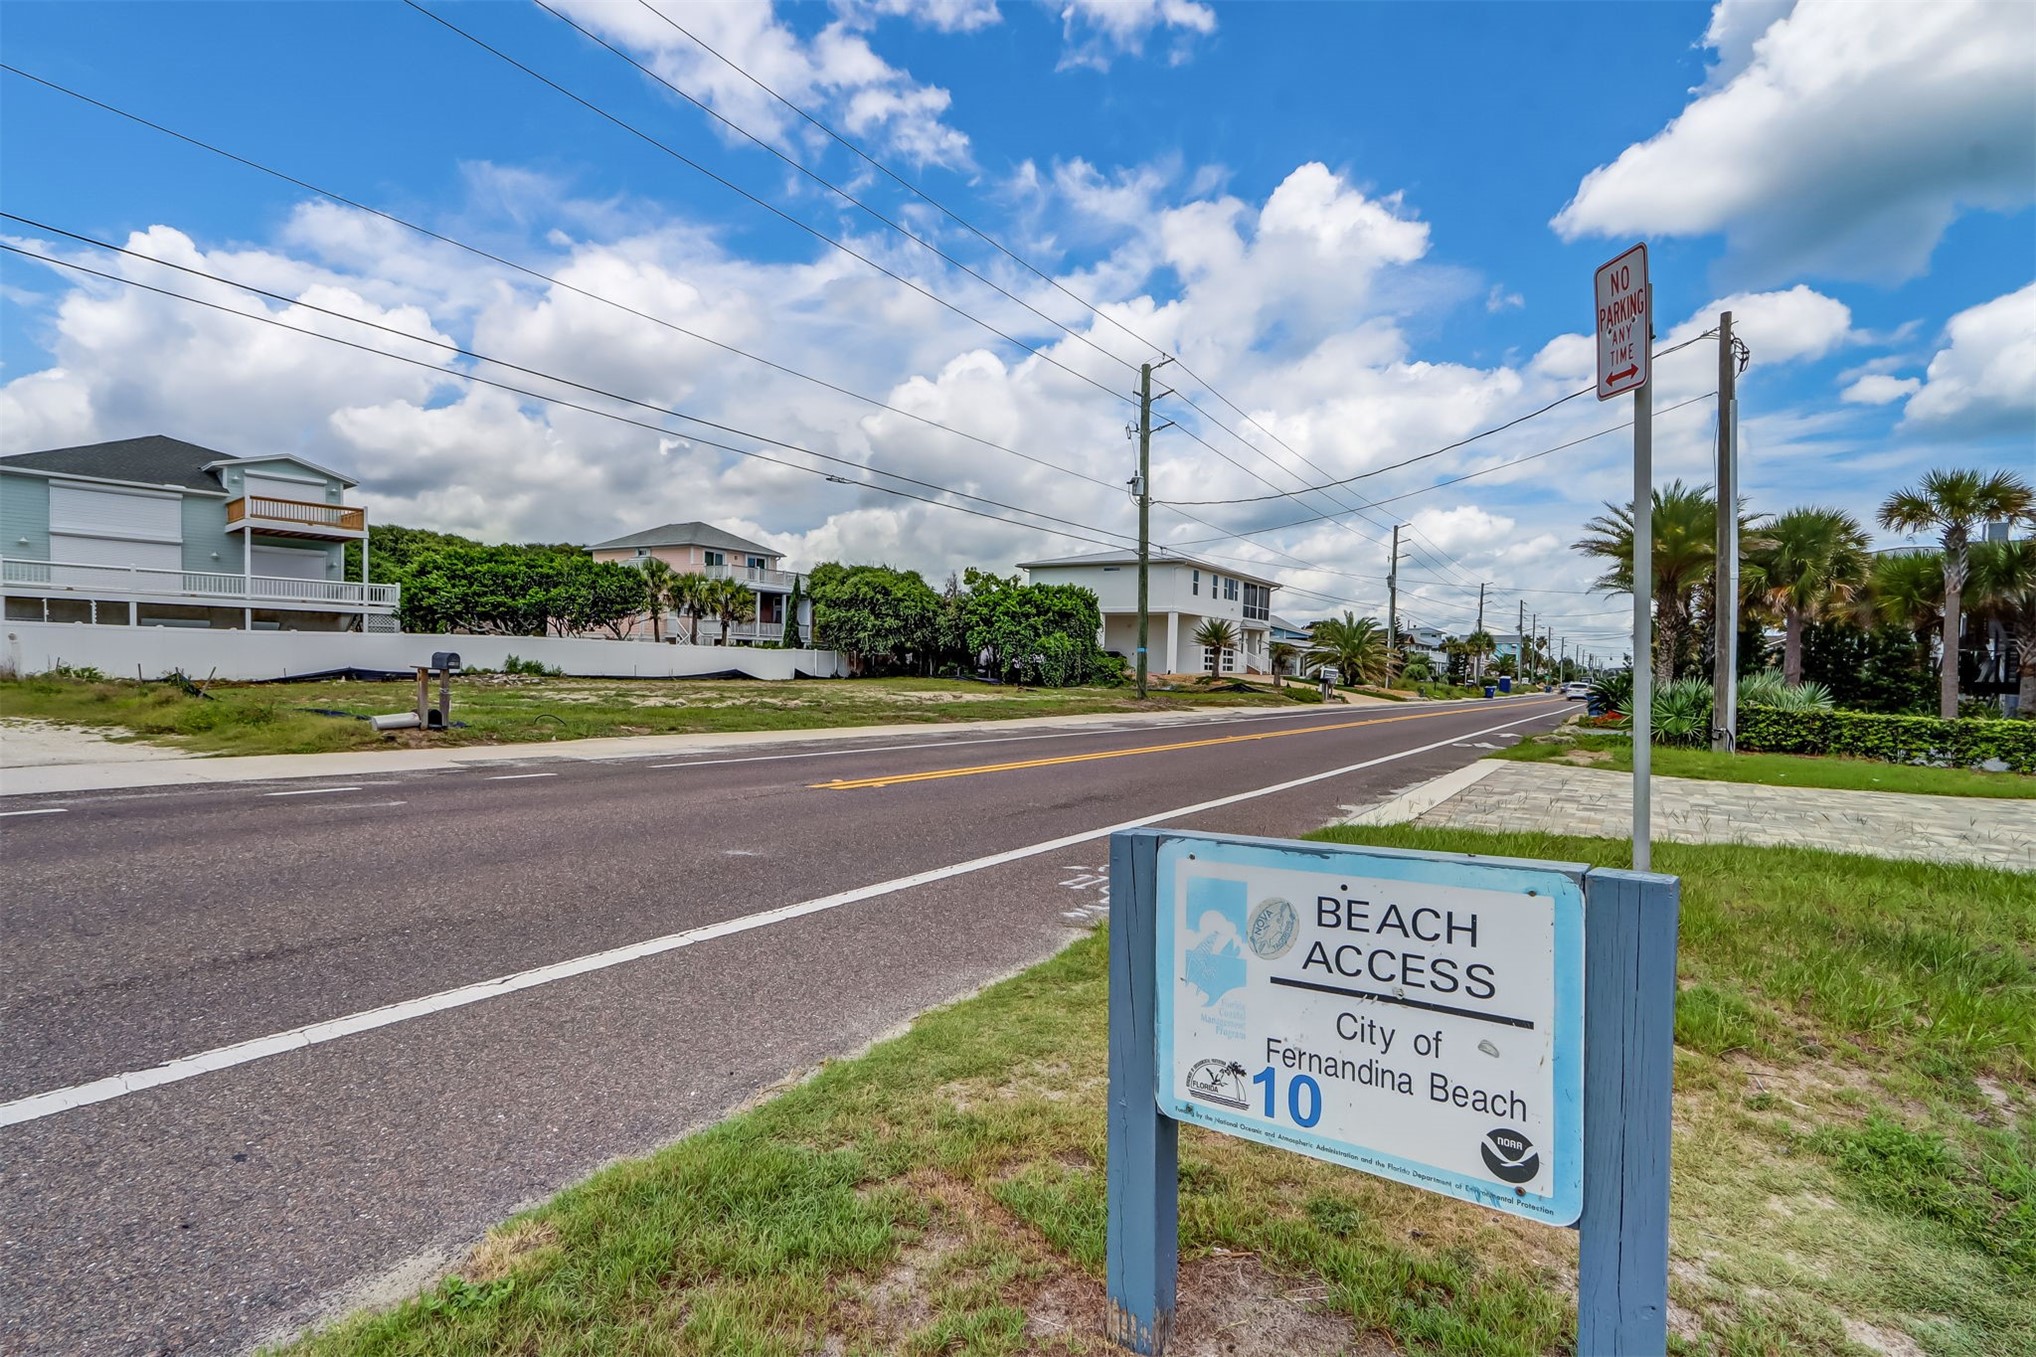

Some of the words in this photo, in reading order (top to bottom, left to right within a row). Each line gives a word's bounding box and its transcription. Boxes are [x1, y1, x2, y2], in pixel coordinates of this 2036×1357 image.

[1610, 265, 1629, 297] NO
[1600, 288, 1644, 332] PARKING
[1610, 343, 1634, 367] TIME
[1612, 323, 1632, 346] ANY
[1254, 909, 1273, 936] NOVA
[1317, 896, 1477, 948] BEACH
[1302, 940, 1497, 999] ACCESS
[1336, 1012, 1395, 1055] City
[1413, 1031, 1443, 1059] of
[1192, 1080, 1219, 1093] FLORIDA
[1253, 1066, 1322, 1128] 10
[1266, 1037, 1414, 1096] Fernandina
[1430, 1072, 1527, 1122] Beach
[1204, 1113, 1213, 1122] the
[1214, 1116, 1239, 1128] National
[1239, 1123, 1262, 1135] Oceanic
[1315, 1144, 1359, 1161] Administration
[1360, 1157, 1373, 1165] and
[1375, 1160, 1386, 1168] the
[1387, 1163, 1411, 1176] Florida
[1412, 1170, 1452, 1187] Department
[1516, 1199, 1554, 1216] Protection
[1497, 1136, 1523, 1151] NOAA
